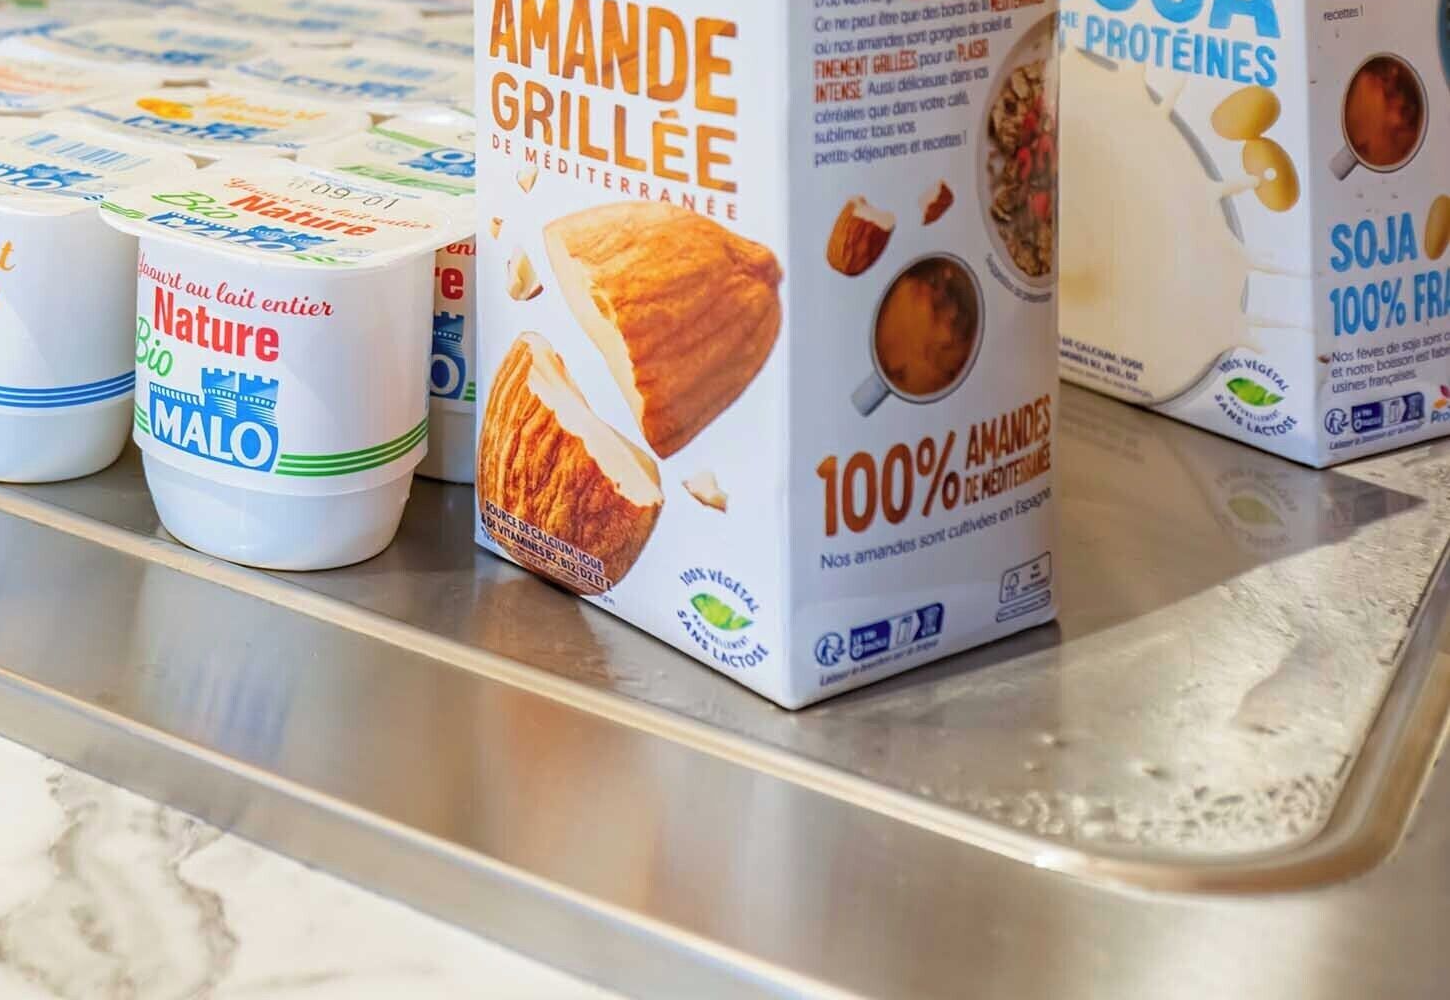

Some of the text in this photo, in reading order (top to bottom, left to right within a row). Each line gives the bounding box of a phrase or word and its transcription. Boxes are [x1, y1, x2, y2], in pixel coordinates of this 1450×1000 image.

[1324, 7, 1359, 21] recettes
[814, 55, 868, 80] FINEMENT
[1086, 14, 1278, 88] PROTÉINES
[815, 80, 862, 103] INTENSE
[491, 71, 738, 194] GRILLÉE
[492, 134, 738, 221] DE MÉDITERRANÉE
[151, 191, 239, 219] Bio
[228, 194, 378, 237] Nature
[1330, 211, 1418, 273] SOJA
[186, 281, 212, 299] au
[216, 281, 257, 309] lait
[262, 295, 335, 317] entier
[1330, 276, 1407, 337] 100%
[154, 286, 280, 362] Nature
[135, 316, 174, 378] Bio
[1331, 367, 1343, 378] et
[1346, 362, 1375, 376] notre
[1377, 354, 1415, 371] boisson
[1332, 351, 1354, 363] Nos
[1357, 346, 1384, 358] fèves
[1386, 341, 1400, 354] de
[1402, 339, 1421, 352] soja
[1422, 333, 1442, 347] sont
[1244, 358, 1289, 392] VÉGÉTAL
[1332, 380, 1367, 394] usines
[154, 397, 274, 469] MALO
[965, 393, 1052, 470] AMANDES
[1214, 394, 1298, 436] SANS LACTOSE
[815, 430, 961, 538] 100%
[964, 474, 980, 506] DE
[486, 500, 518, 529] SOURCE
[519, 519, 530, 534] DE
[578, 551, 604, 573] IODE
[486, 517, 497, 531] DE
[498, 525, 545, 557] VITAMINES
[820, 553, 850, 569] Nos
[855, 538, 917, 564] amandes
[919, 528, 946, 548] sont
[947, 509, 999, 539] cultivées
[999, 506, 1014, 521] en
[708, 569, 760, 614] VÉGÉTAL
[677, 610, 769, 669] SANS LACTOSE
